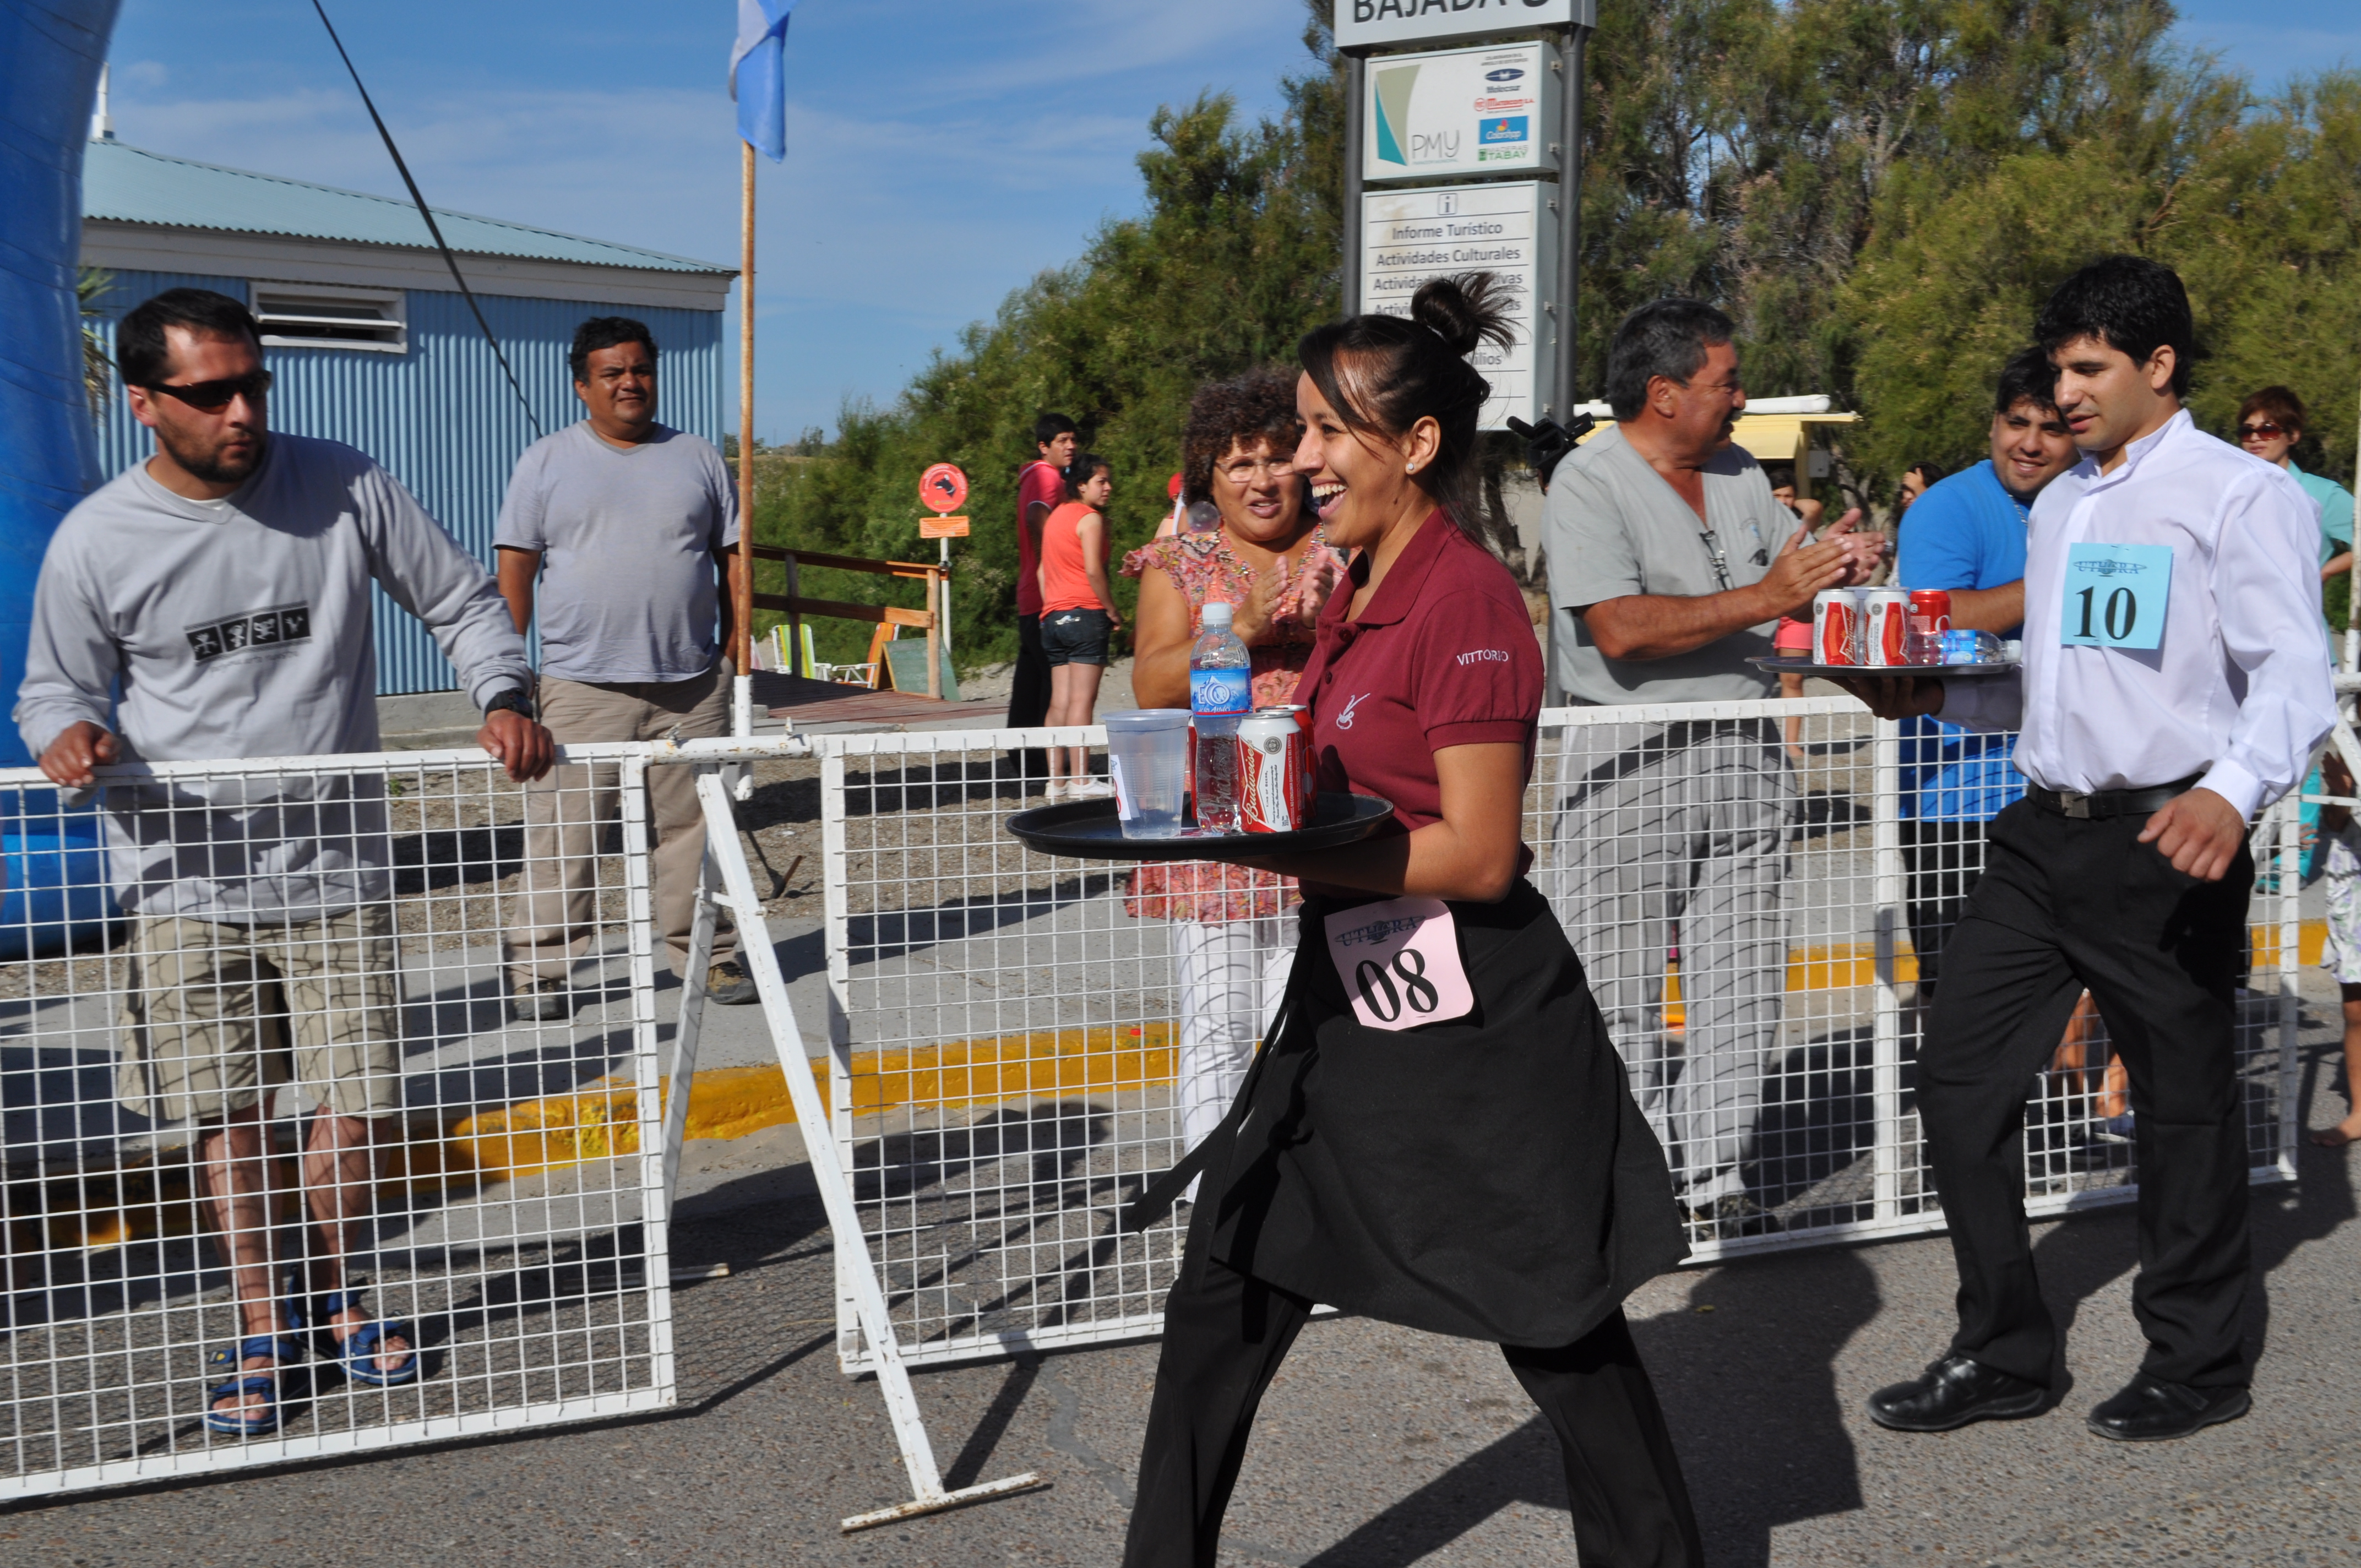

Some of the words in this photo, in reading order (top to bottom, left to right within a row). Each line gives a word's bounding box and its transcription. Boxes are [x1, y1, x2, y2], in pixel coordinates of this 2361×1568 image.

[1354, 0, 1506, 23] BAJ
[1488, 150, 1527, 160] TABAY
[1392, 226, 1443, 239] Informe
[1446, 222, 1503, 236] Turístico
[1377, 251, 1449, 266] Actividades
[1452, 247, 1520, 262] Culturales
[1373, 275, 1433, 290] Activida
[1374, 303, 1412, 316] Activi
[2073, 586, 2136, 640] 10
[1457, 649, 1509, 666] VITTORIO
[1198, 683, 1231, 707] ECO
[1245, 739, 1259, 825] Budweiser
[1341, 917, 1417, 946] UTHGRA
[1356, 949, 1439, 1022] 08
